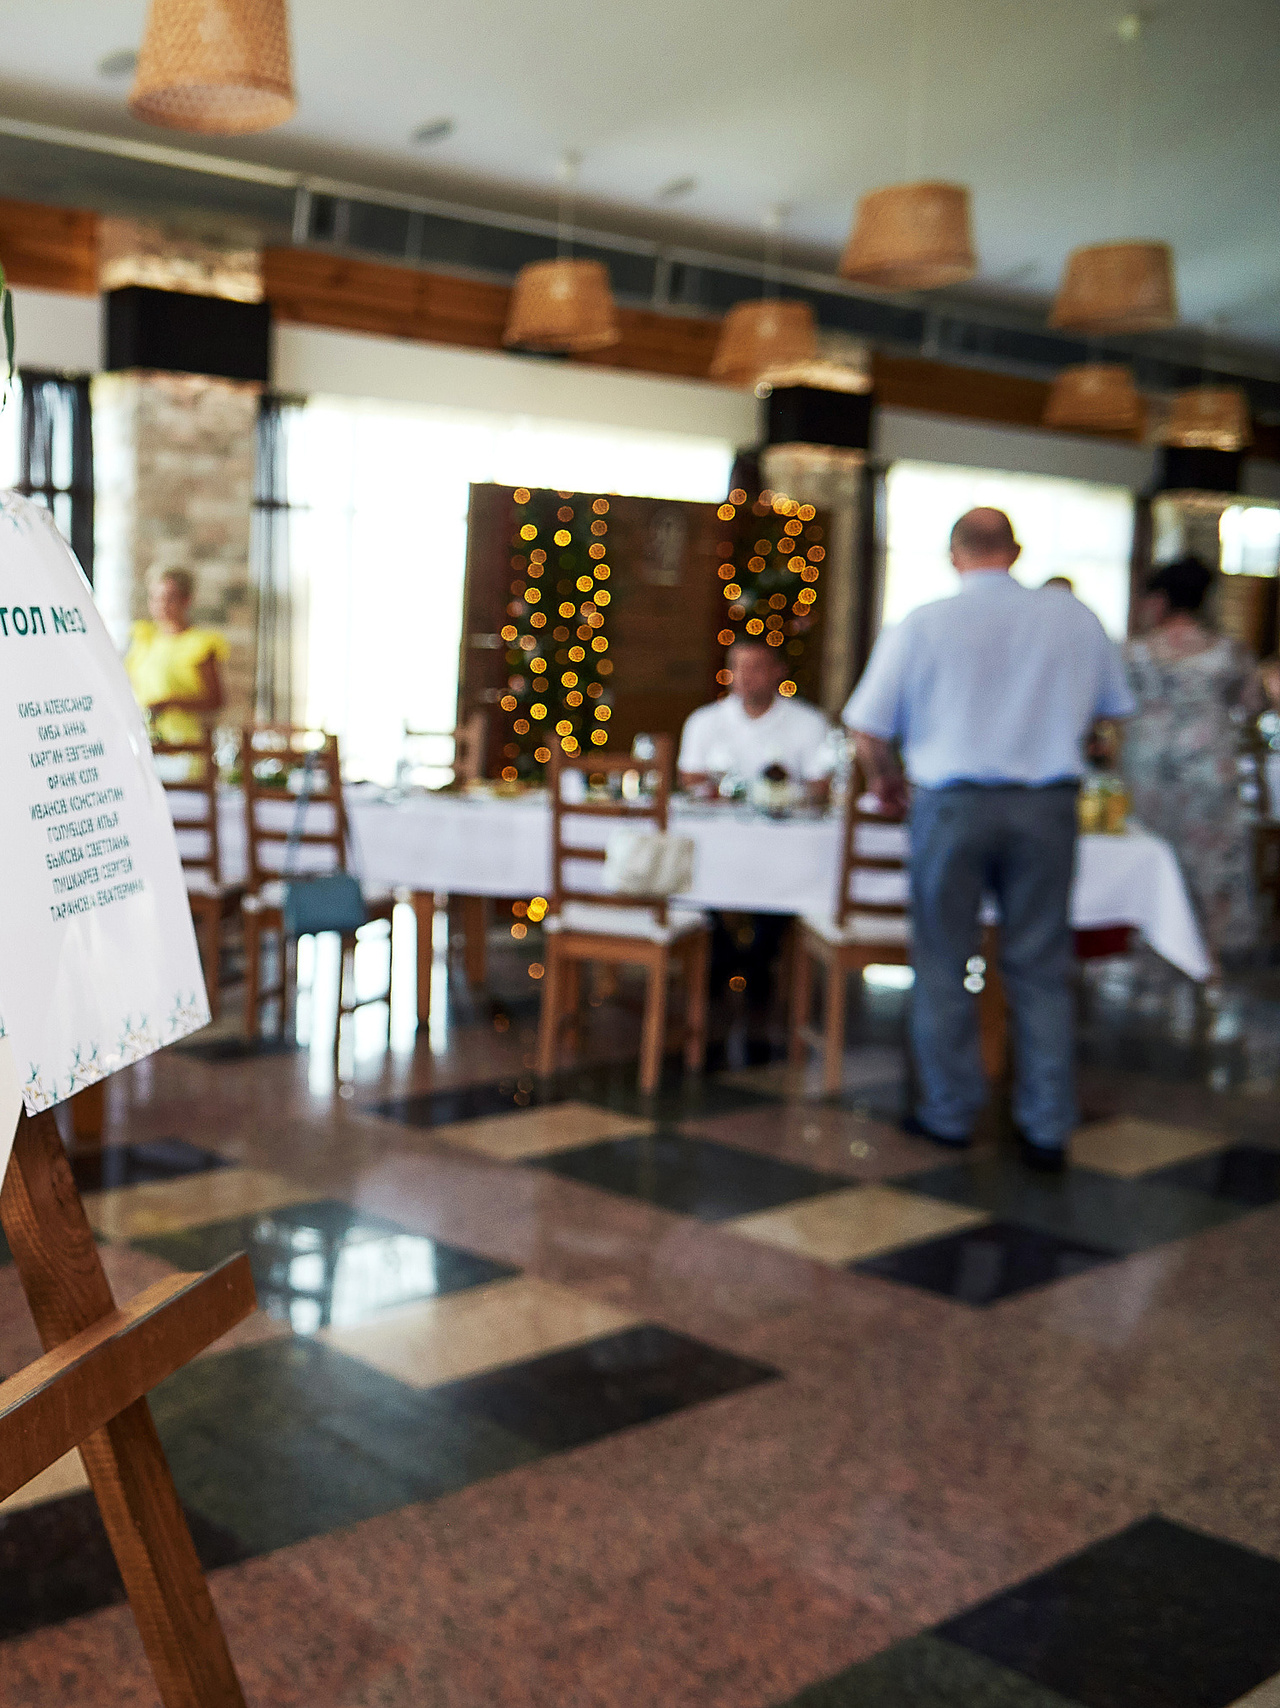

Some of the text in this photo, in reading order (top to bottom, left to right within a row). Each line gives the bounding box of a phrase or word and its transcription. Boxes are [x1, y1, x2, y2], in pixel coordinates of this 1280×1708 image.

[44, 696, 93, 715] АЛЕКСАНДР
[30, 788, 124, 820] ИВАНОВ КОНСТАНТИН
[45, 834, 130, 869] БЫКОВА СВЕТЛАНА
